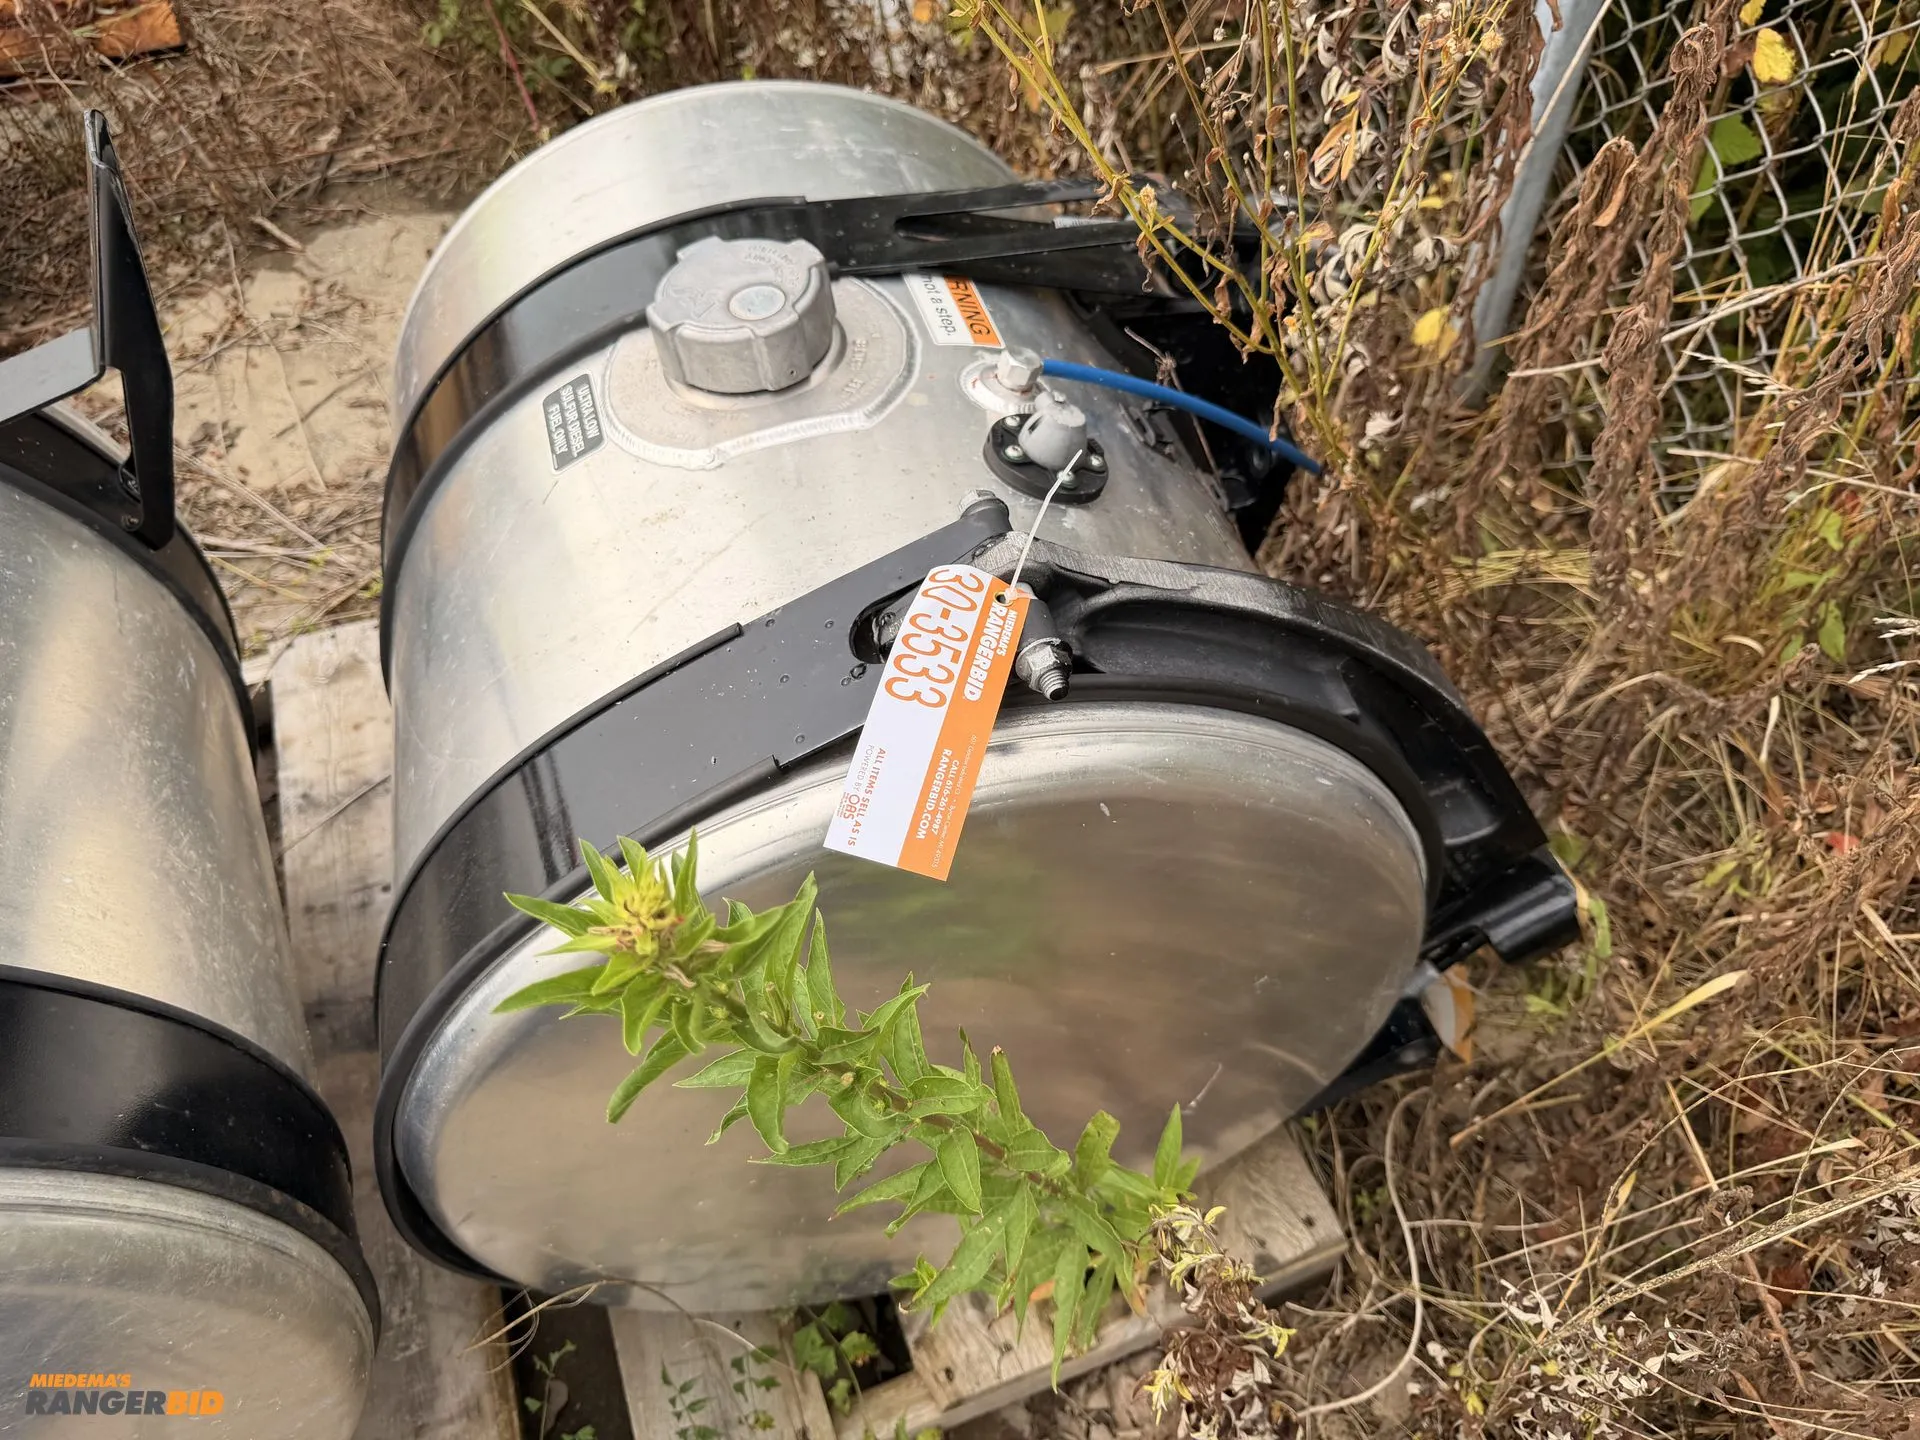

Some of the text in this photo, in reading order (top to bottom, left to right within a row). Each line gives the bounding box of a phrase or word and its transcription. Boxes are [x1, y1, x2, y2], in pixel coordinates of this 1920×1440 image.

[935, 306, 957, 336] step.
[945, 279, 991, 334] RNING
[547, 403, 568, 454] FUEL ONLY
[559, 384, 584, 457] SULFUR DIESEL
[575, 383, 600, 438] ULTRA LOW
[884, 568, 985, 709] 30-3533
[963, 602, 1008, 702] RANGERBID
[997, 610, 1018, 656] MIEDEMA'S
[852, 781, 862, 792] BY
[856, 743, 874, 781] POWERED
[842, 792, 861, 820] OAS
[846, 747, 886, 847] ALL ITEMS SELL AS IS
[916, 748, 952, 840] RANGERBID.COM
[931, 759, 960, 836] CALL 616-261-4987
